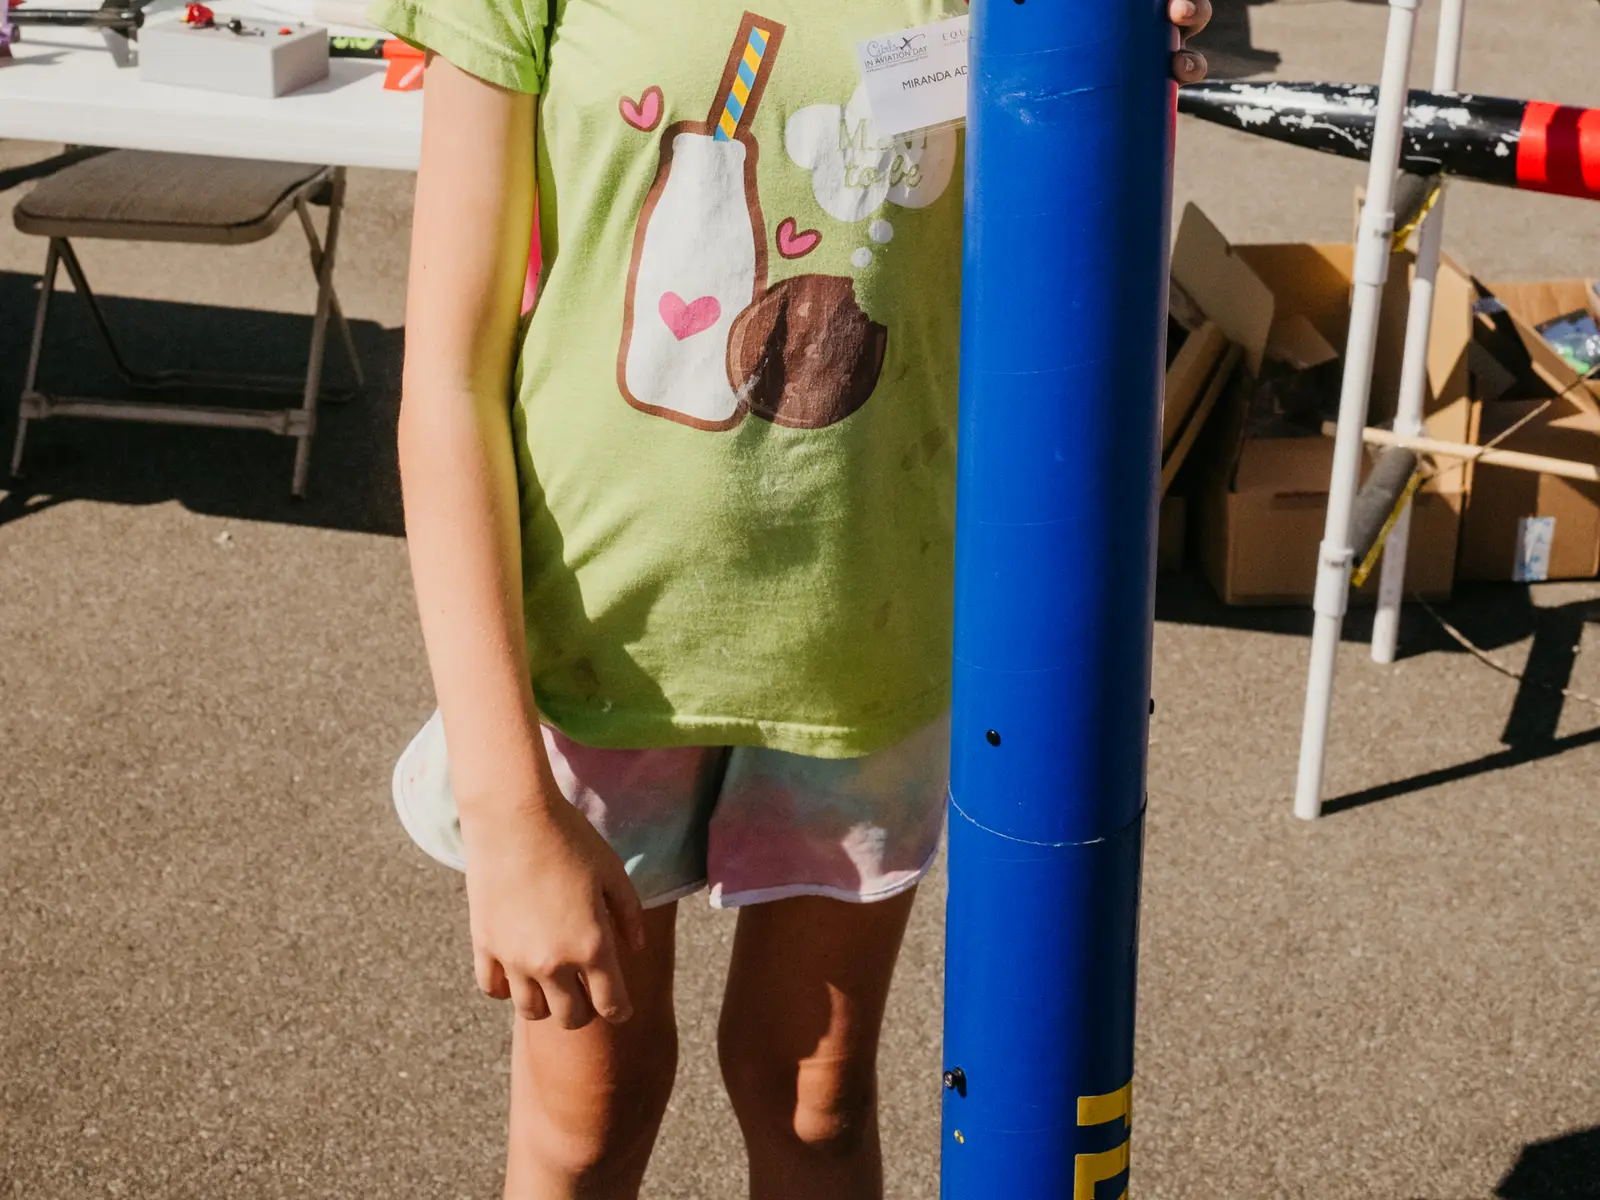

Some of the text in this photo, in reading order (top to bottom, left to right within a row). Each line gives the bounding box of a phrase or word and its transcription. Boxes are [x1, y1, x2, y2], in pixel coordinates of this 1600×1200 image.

[864, 59, 873, 68] IN
[875, 50, 911, 66] AVIATION
[913, 45, 928, 55] DAY
[867, 39, 901, 58] Girls
[902, 69, 952, 90] MIRANDA
